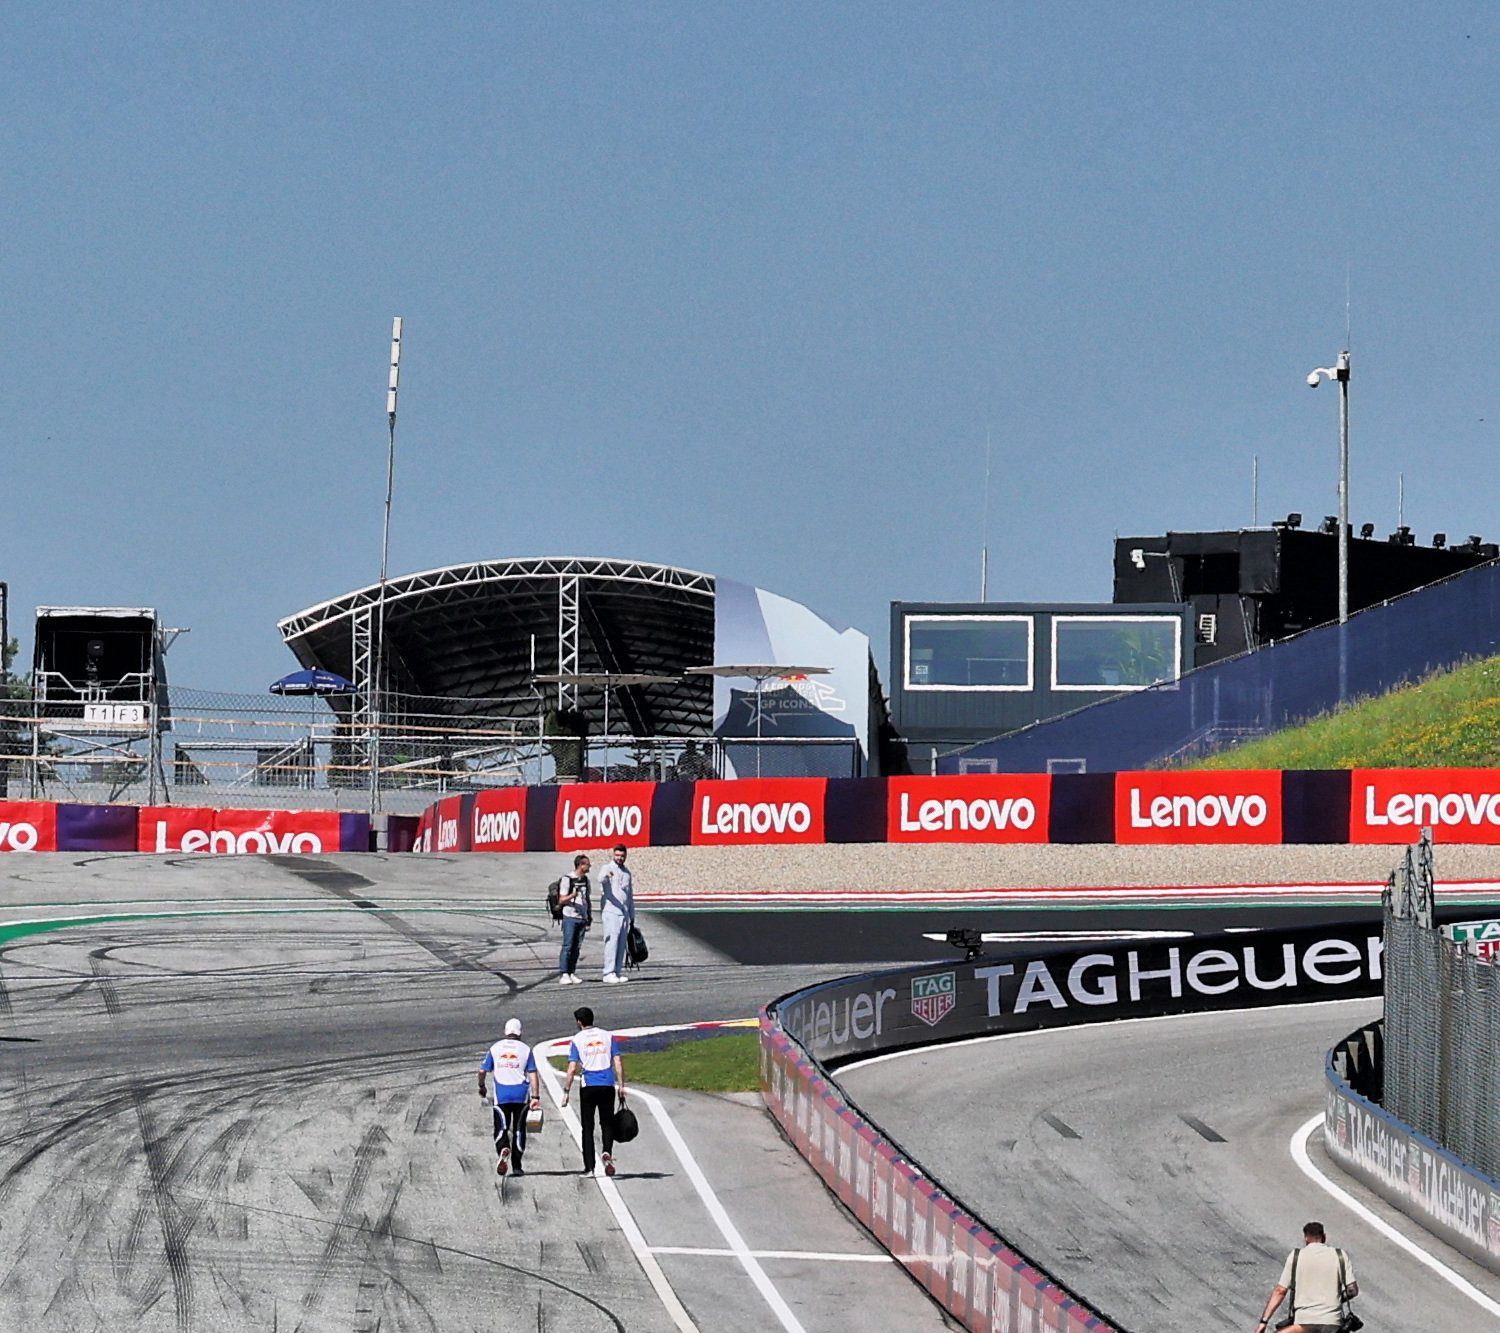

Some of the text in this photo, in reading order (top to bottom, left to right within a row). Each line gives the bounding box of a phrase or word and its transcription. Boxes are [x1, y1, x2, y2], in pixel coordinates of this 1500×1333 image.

[474, 806, 520, 844] Lenovo
[562, 800, 642, 838] Lenovo
[701, 795, 811, 834] Lenovo
[900, 793, 1035, 832] Lenovo
[1130, 788, 1267, 828] Lenovo
[155, 820, 322, 853] Lenovo
[914, 976, 952, 996] TAG
[913, 994, 953, 1022] HEUER
